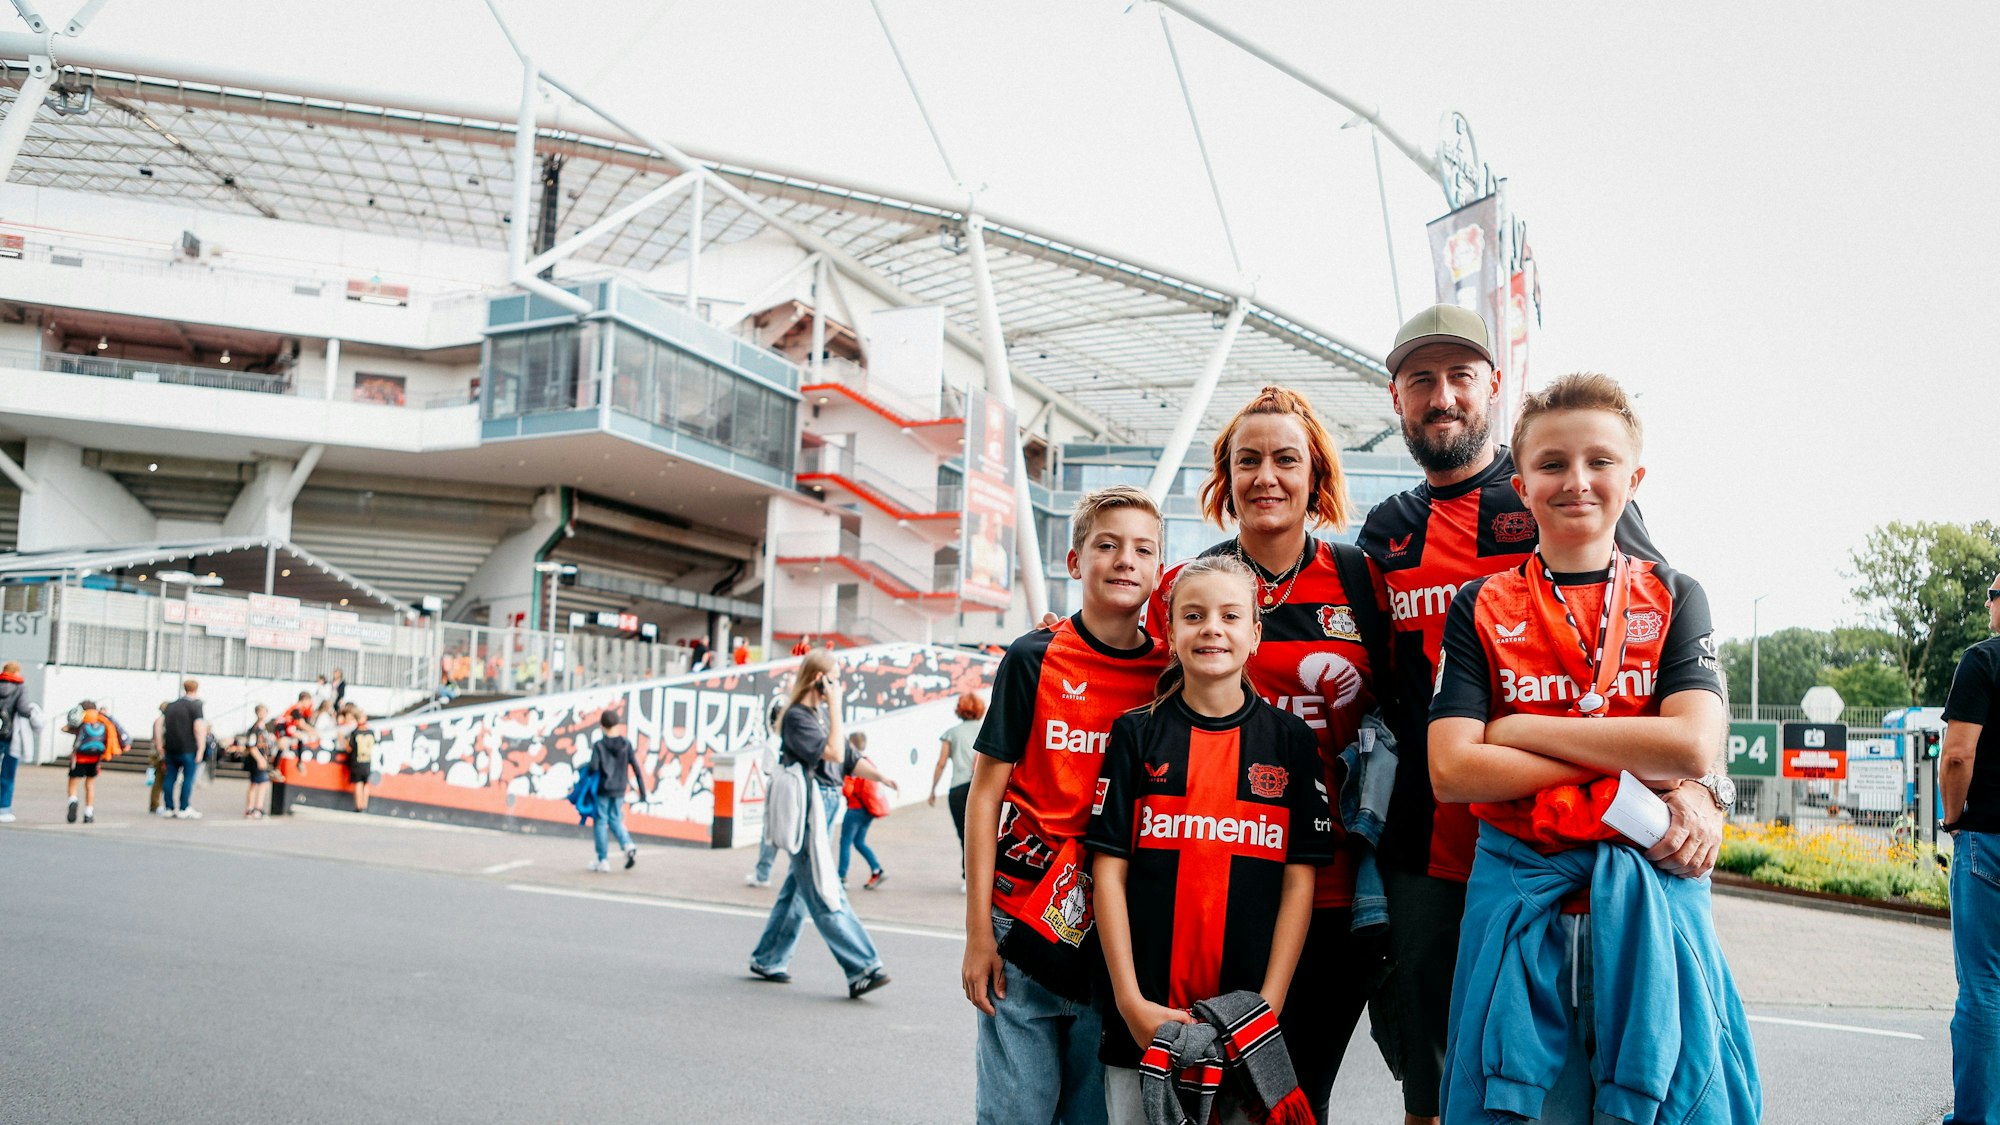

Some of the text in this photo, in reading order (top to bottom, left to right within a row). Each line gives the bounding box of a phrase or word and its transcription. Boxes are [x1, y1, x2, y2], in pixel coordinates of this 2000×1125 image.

[1496, 636, 1526, 644] CASTORE
[1061, 693, 1086, 701] CASTORE
[1727, 735, 1768, 764] P4
[1140, 804, 1284, 850] Barmenia
